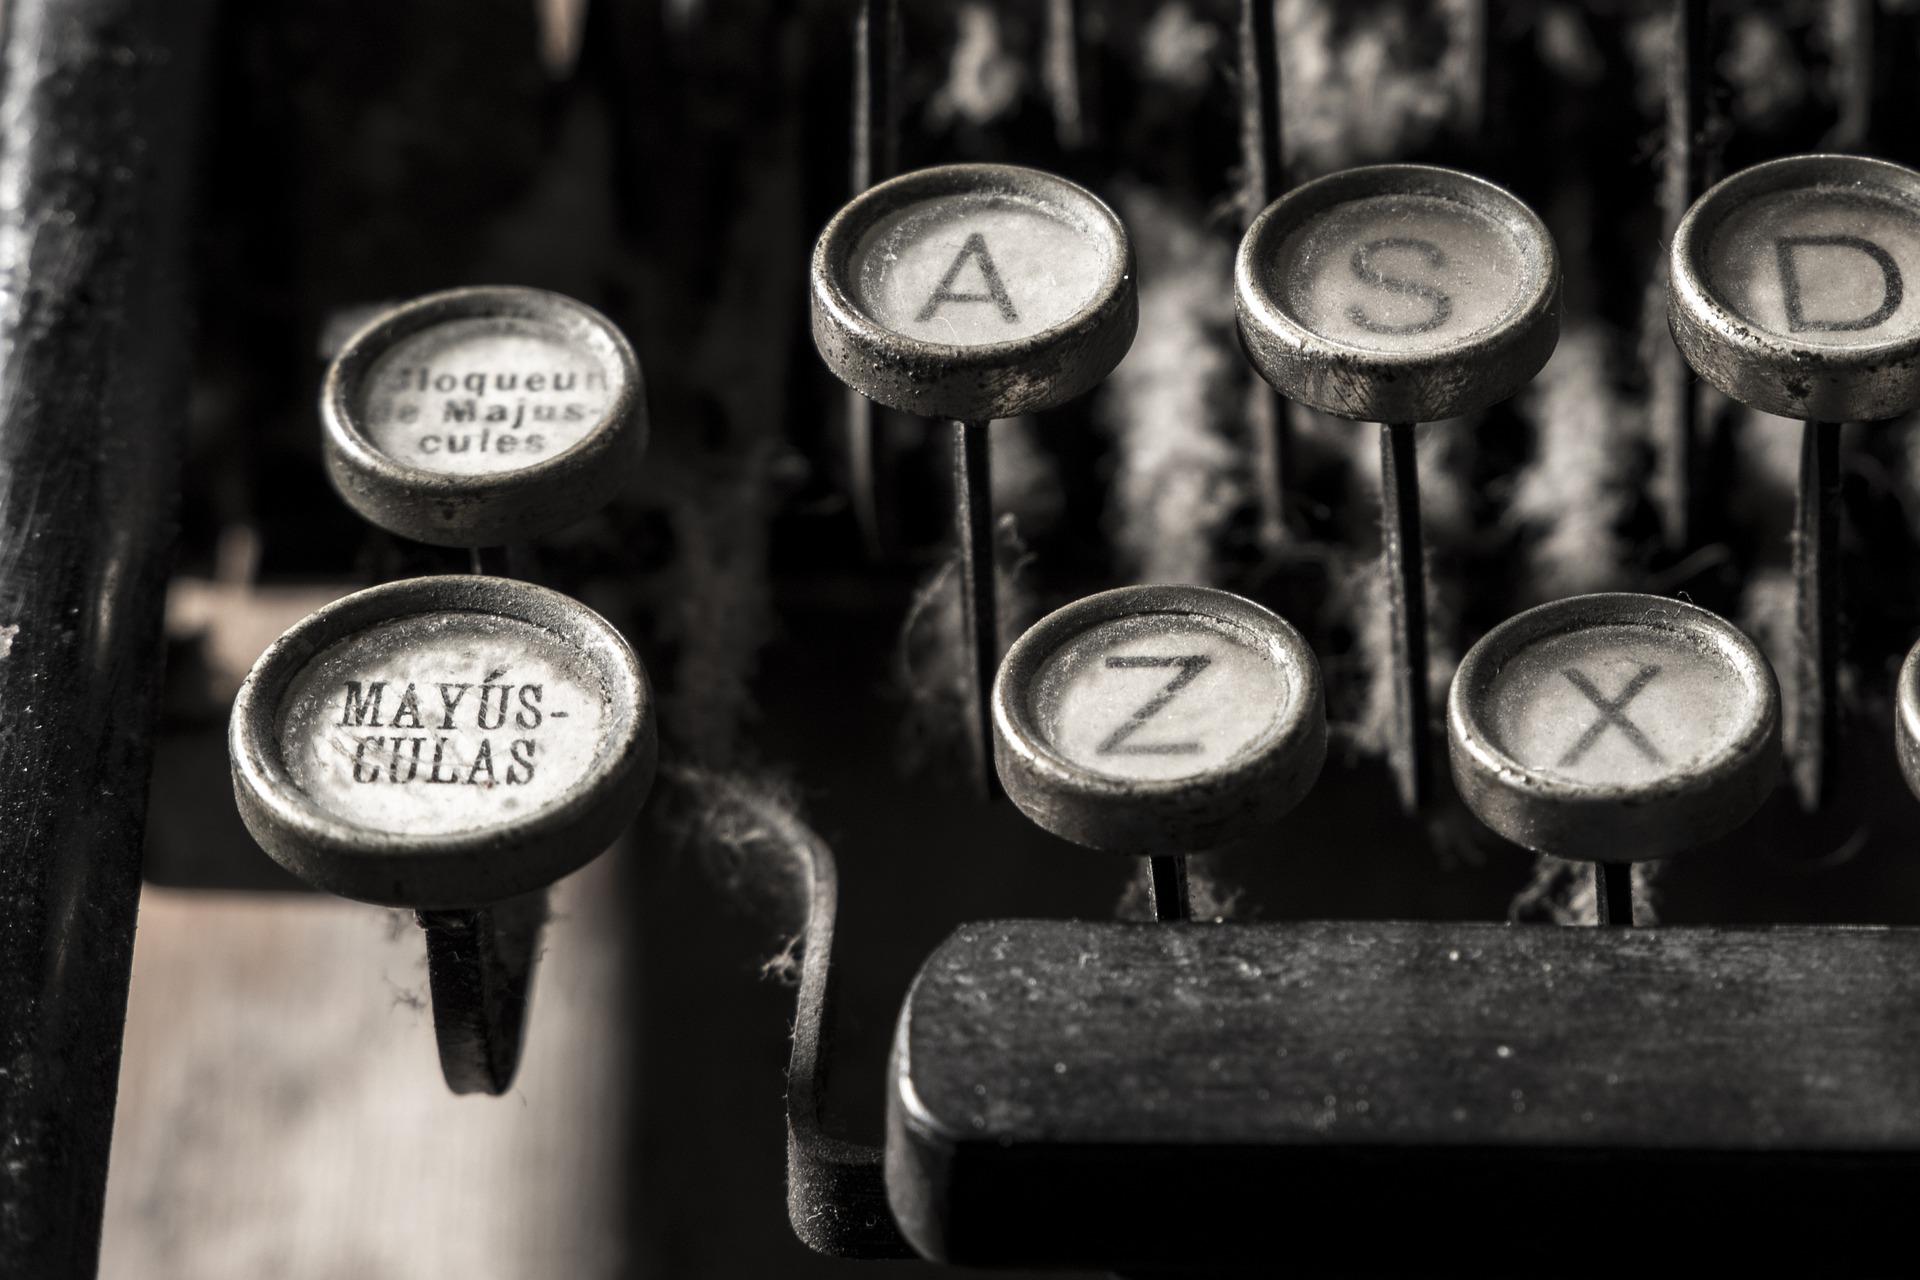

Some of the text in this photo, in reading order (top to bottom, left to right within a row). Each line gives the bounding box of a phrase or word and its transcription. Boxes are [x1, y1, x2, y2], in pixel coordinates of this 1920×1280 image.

[916, 231, 1018, 325] A
[1348, 238, 1453, 333] S
[1775, 235, 1903, 333] D
[419, 430, 547, 455] cules
[337, 666, 569, 730] MAYÚS-
[1096, 654, 1210, 756] Z
[1558, 664, 1666, 768] X
[353, 738, 536, 784] CULAS
